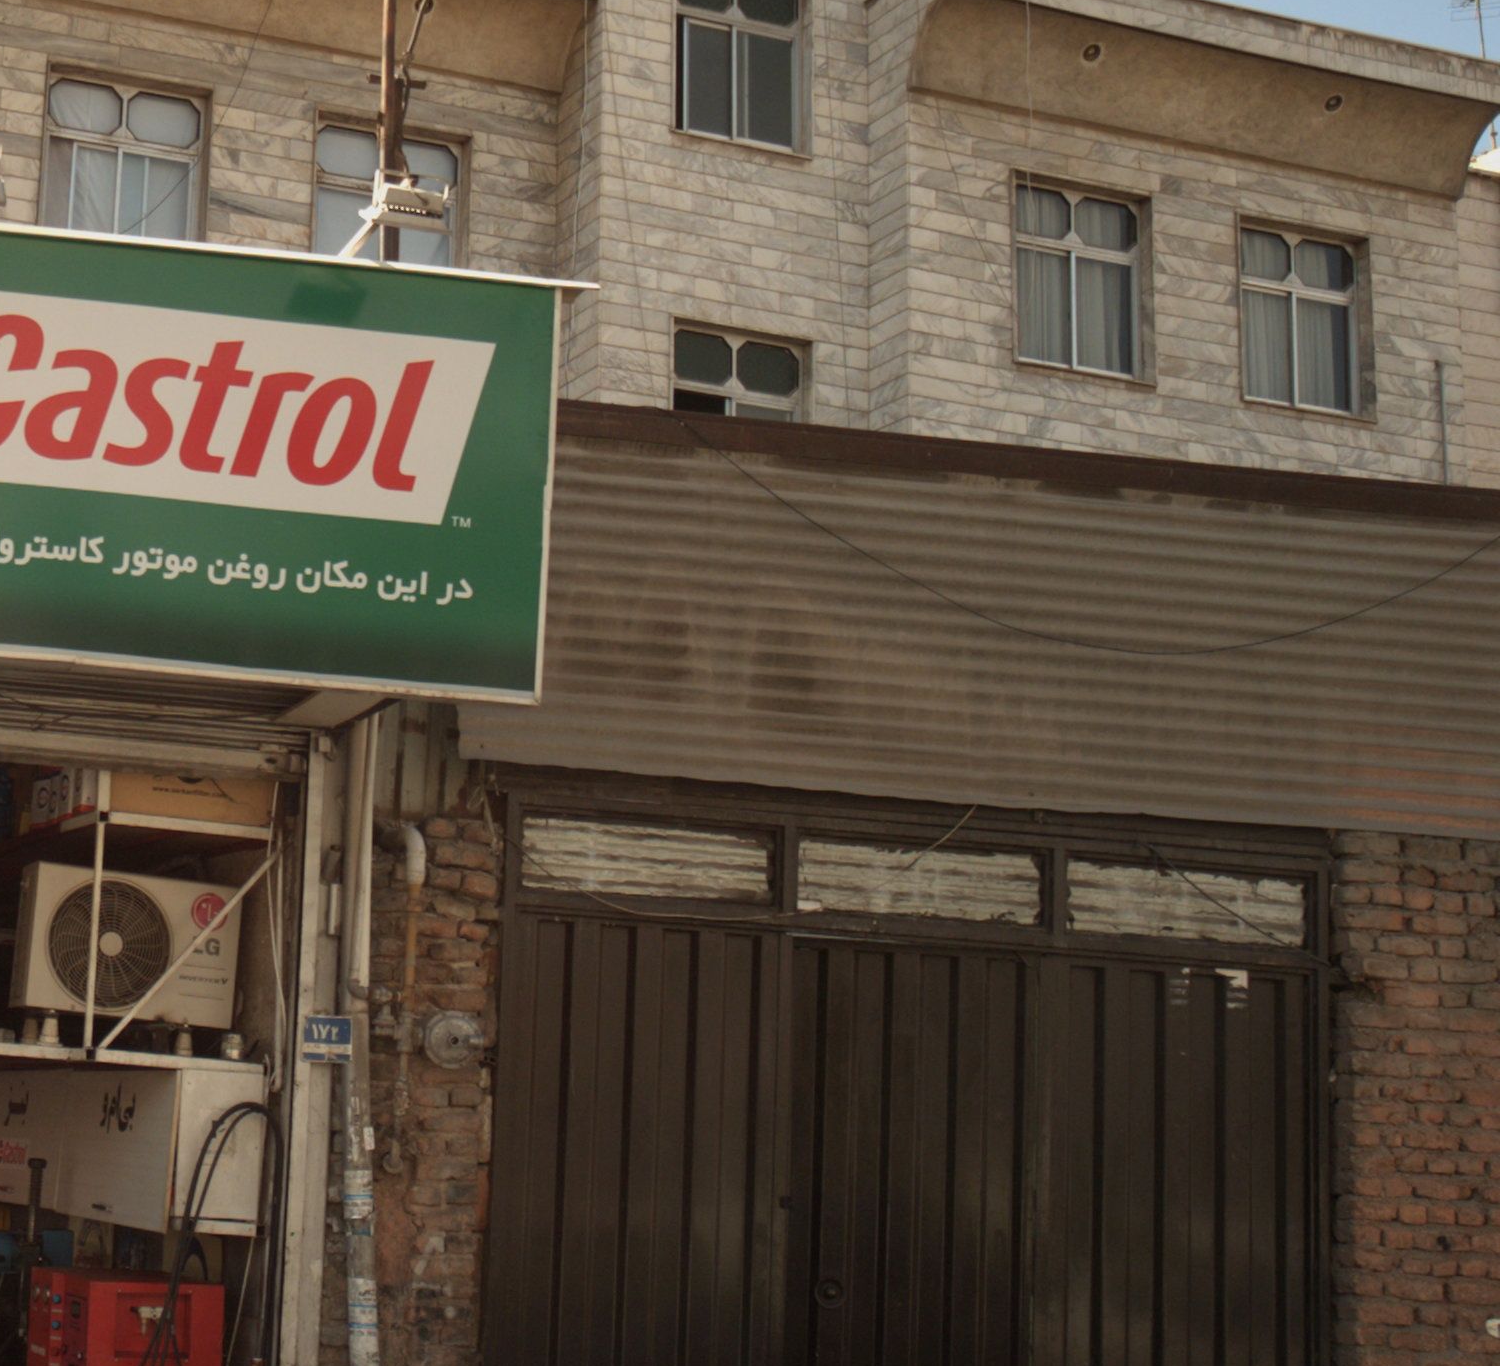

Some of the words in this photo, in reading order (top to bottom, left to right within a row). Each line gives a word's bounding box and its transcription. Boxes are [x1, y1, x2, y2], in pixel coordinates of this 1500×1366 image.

[112, 547, 198, 580] موتور
[207, 553, 287, 590] روغن
[295, 560, 368, 594] مکان
[376, 571, 428, 603] این
[435, 578, 474, 605] در
